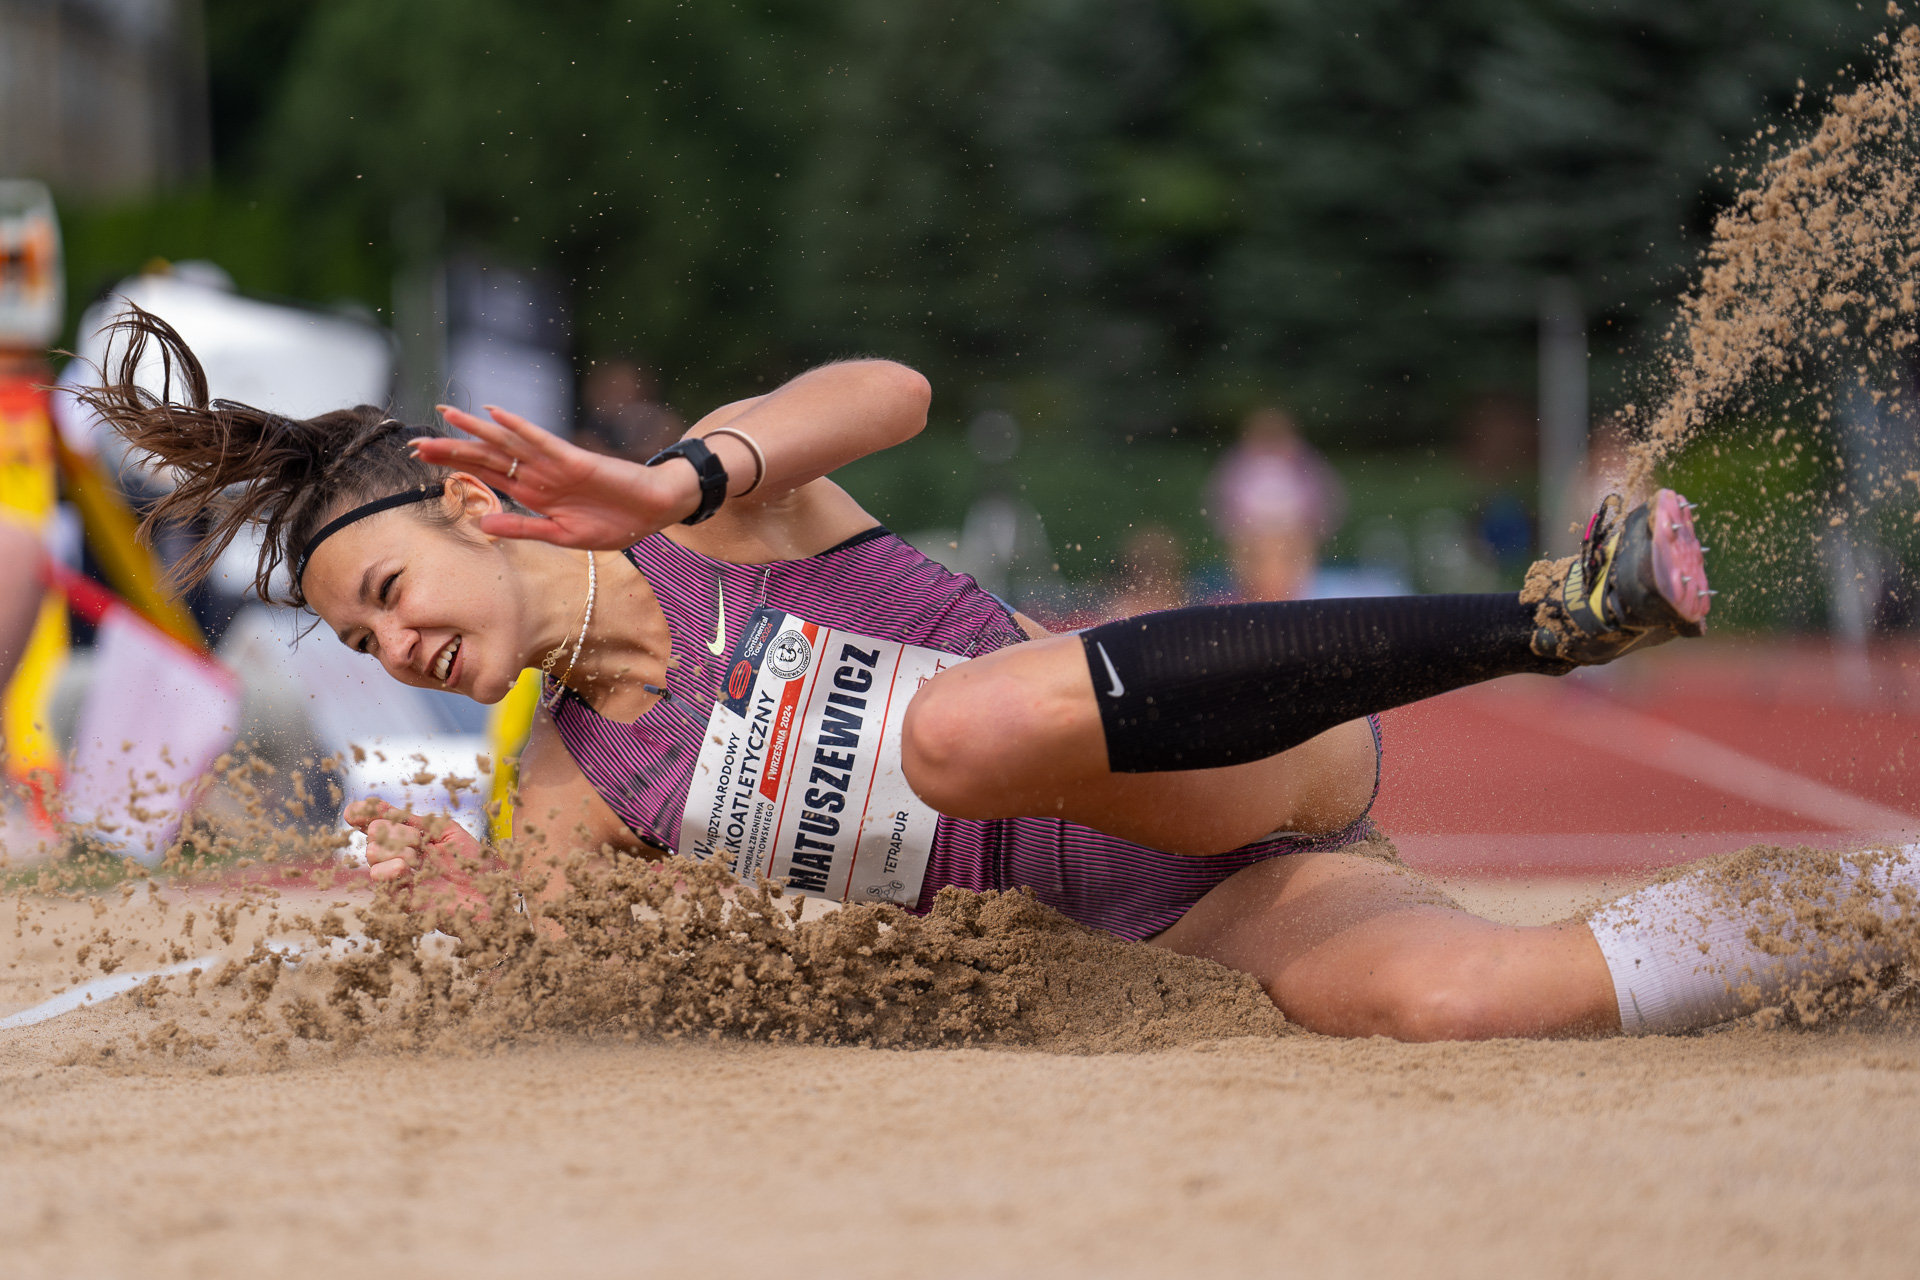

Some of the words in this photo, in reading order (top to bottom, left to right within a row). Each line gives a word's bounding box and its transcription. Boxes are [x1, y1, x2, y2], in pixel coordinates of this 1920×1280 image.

[744, 616, 769, 658] Continental
[751, 642, 764, 657] Tour
[760, 622, 773, 643] 2024
[769, 729, 787, 776] WRZEŚNIA
[781, 704, 794, 728] 2024
[786, 643, 880, 893] MATUSZEWICZ
[706, 732, 740, 849] MIĘDZYNARODOWY
[742, 846, 754, 880] MEMORIAŁ
[749, 802, 765, 845] ZBIGNIEWA
[883, 810, 909, 874] TETRAPUR
